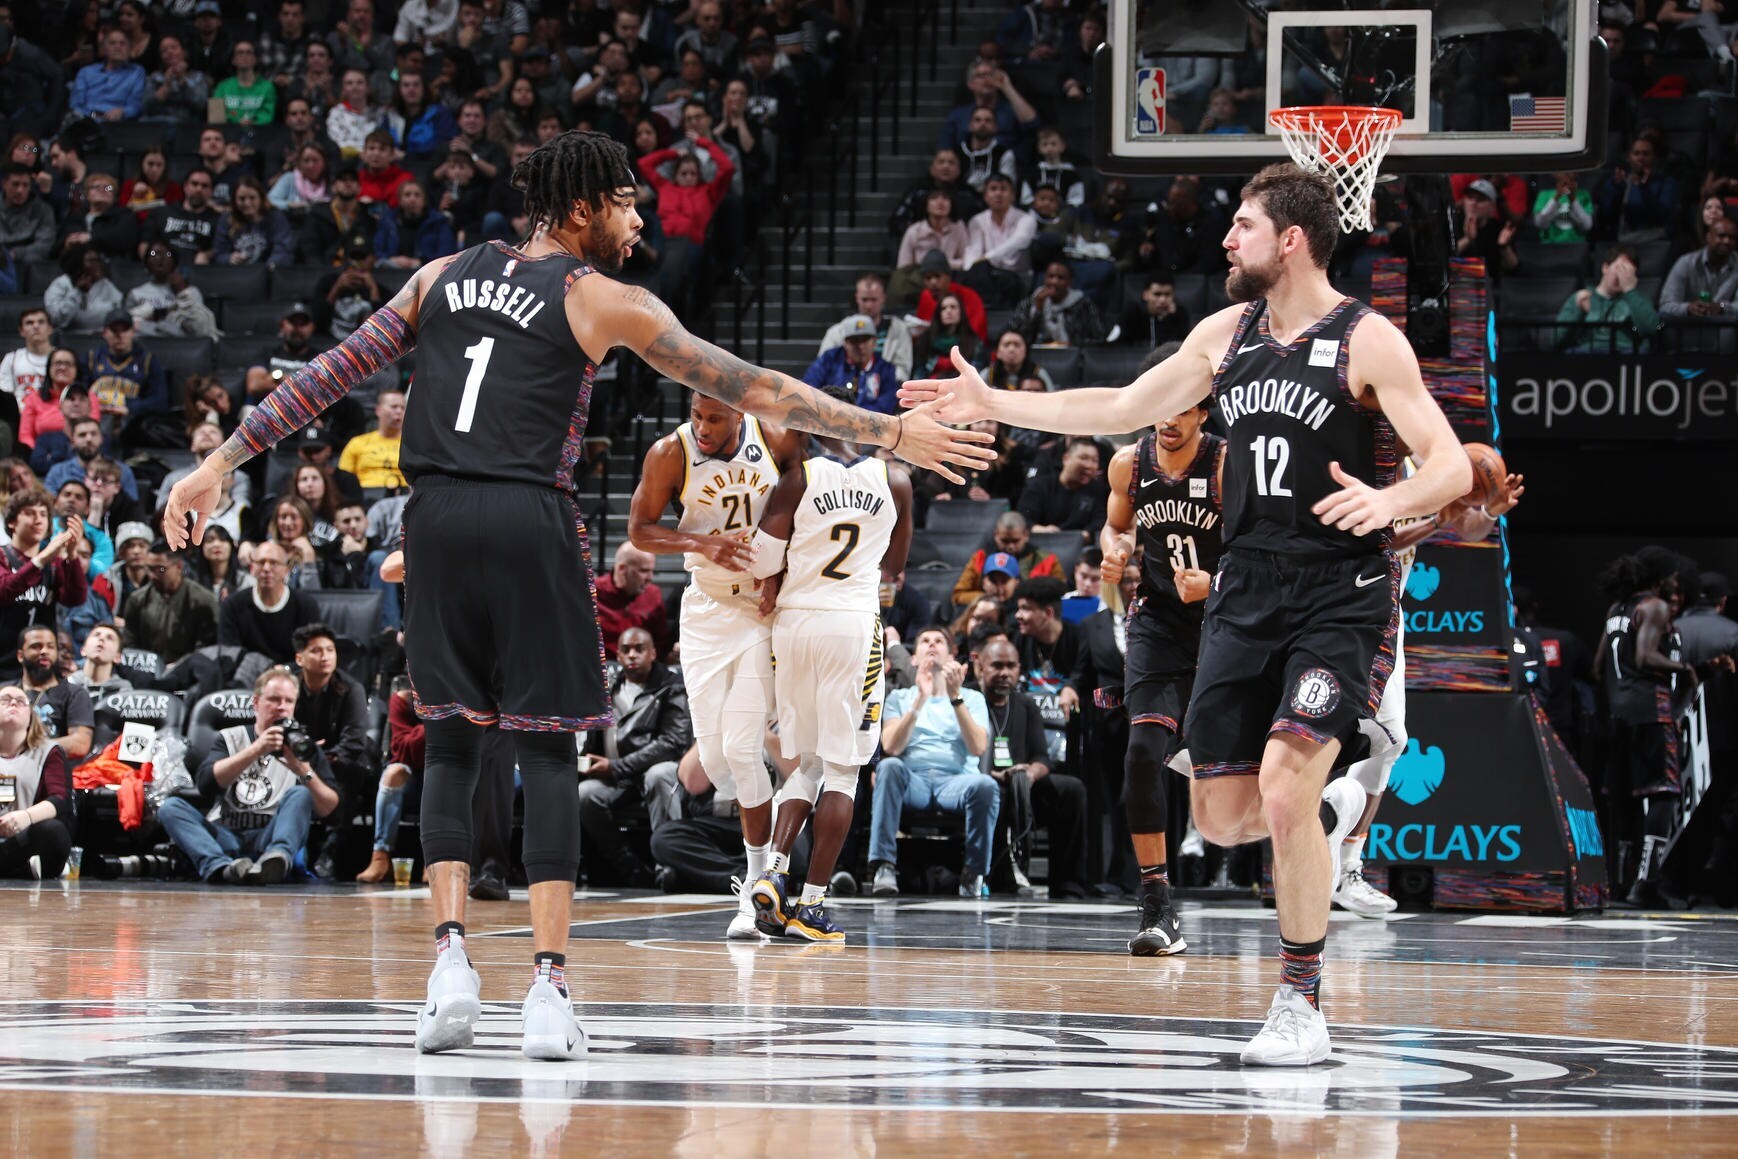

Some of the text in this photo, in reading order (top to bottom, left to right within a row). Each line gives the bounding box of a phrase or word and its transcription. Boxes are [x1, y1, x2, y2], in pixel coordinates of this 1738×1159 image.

[445, 279, 545, 329] RUSSELL
[1313, 347, 1335, 358] infor
[455, 337, 495, 432] 1
[1219, 378, 1336, 431] BROOKLYN
[1250, 435, 1293, 497] 12
[697, 469, 770, 506] INDIANA
[813, 489, 884, 516] COLLISON
[722, 493, 752, 531] 21
[1136, 499, 1219, 530] BROOKLYN
[821, 522, 860, 580] 2
[1166, 533, 1200, 572] 31
[1403, 611, 1484, 632] RCLAYS
[107, 694, 170, 712] QATAR
[120, 708, 168, 719] AIRWAYS
[210, 693, 255, 712] QATA
[1360, 823, 1522, 861] RCLAYS
